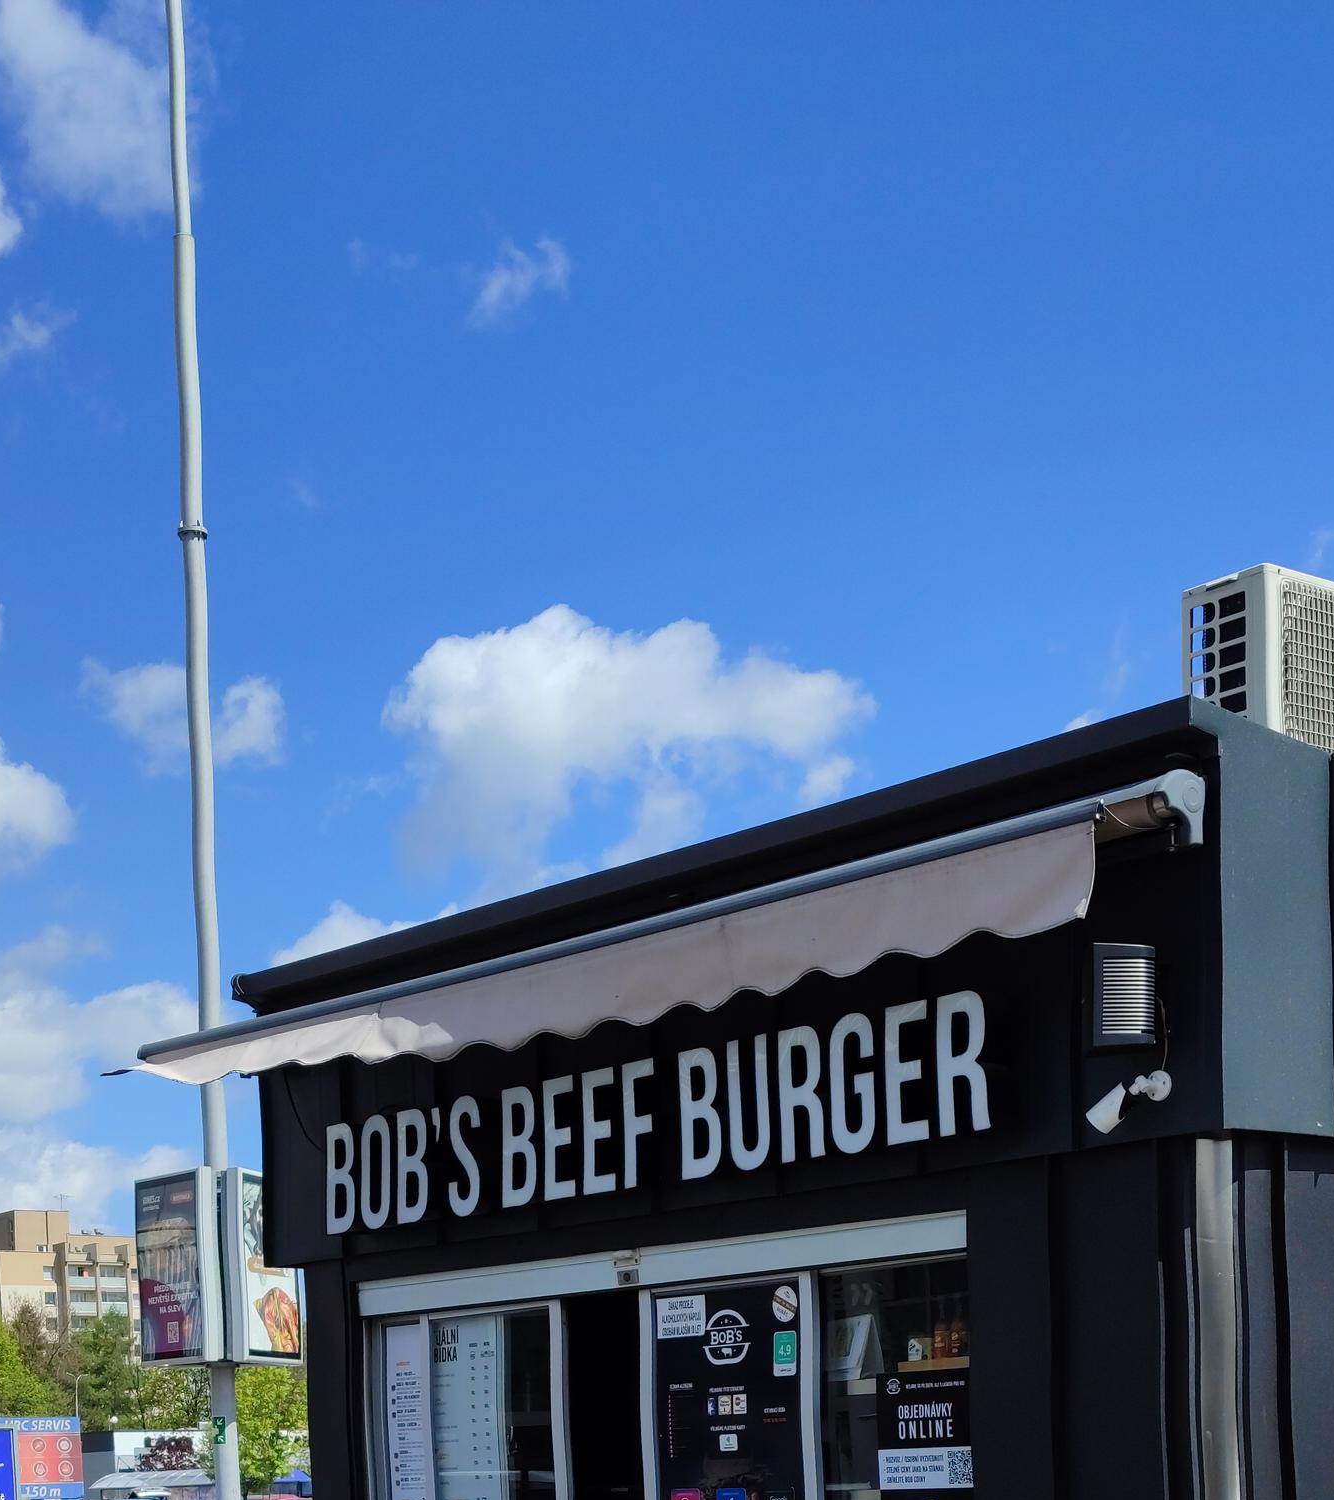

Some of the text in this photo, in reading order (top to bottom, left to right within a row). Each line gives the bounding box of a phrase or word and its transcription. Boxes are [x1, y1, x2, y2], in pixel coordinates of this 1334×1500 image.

[325, 990, 991, 1236] BOB'S BEEF BURGER
[710, 1328, 743, 1345] BOB'S
[778, 1344, 792, 1357] 4,9
[898, 1401, 953, 1420] OBJEDNÁVKY
[31, 1419, 72, 1431] SERVIS
[898, 1419, 954, 1440] ONLINE
[24, 1486, 61, 1497] 150 m
